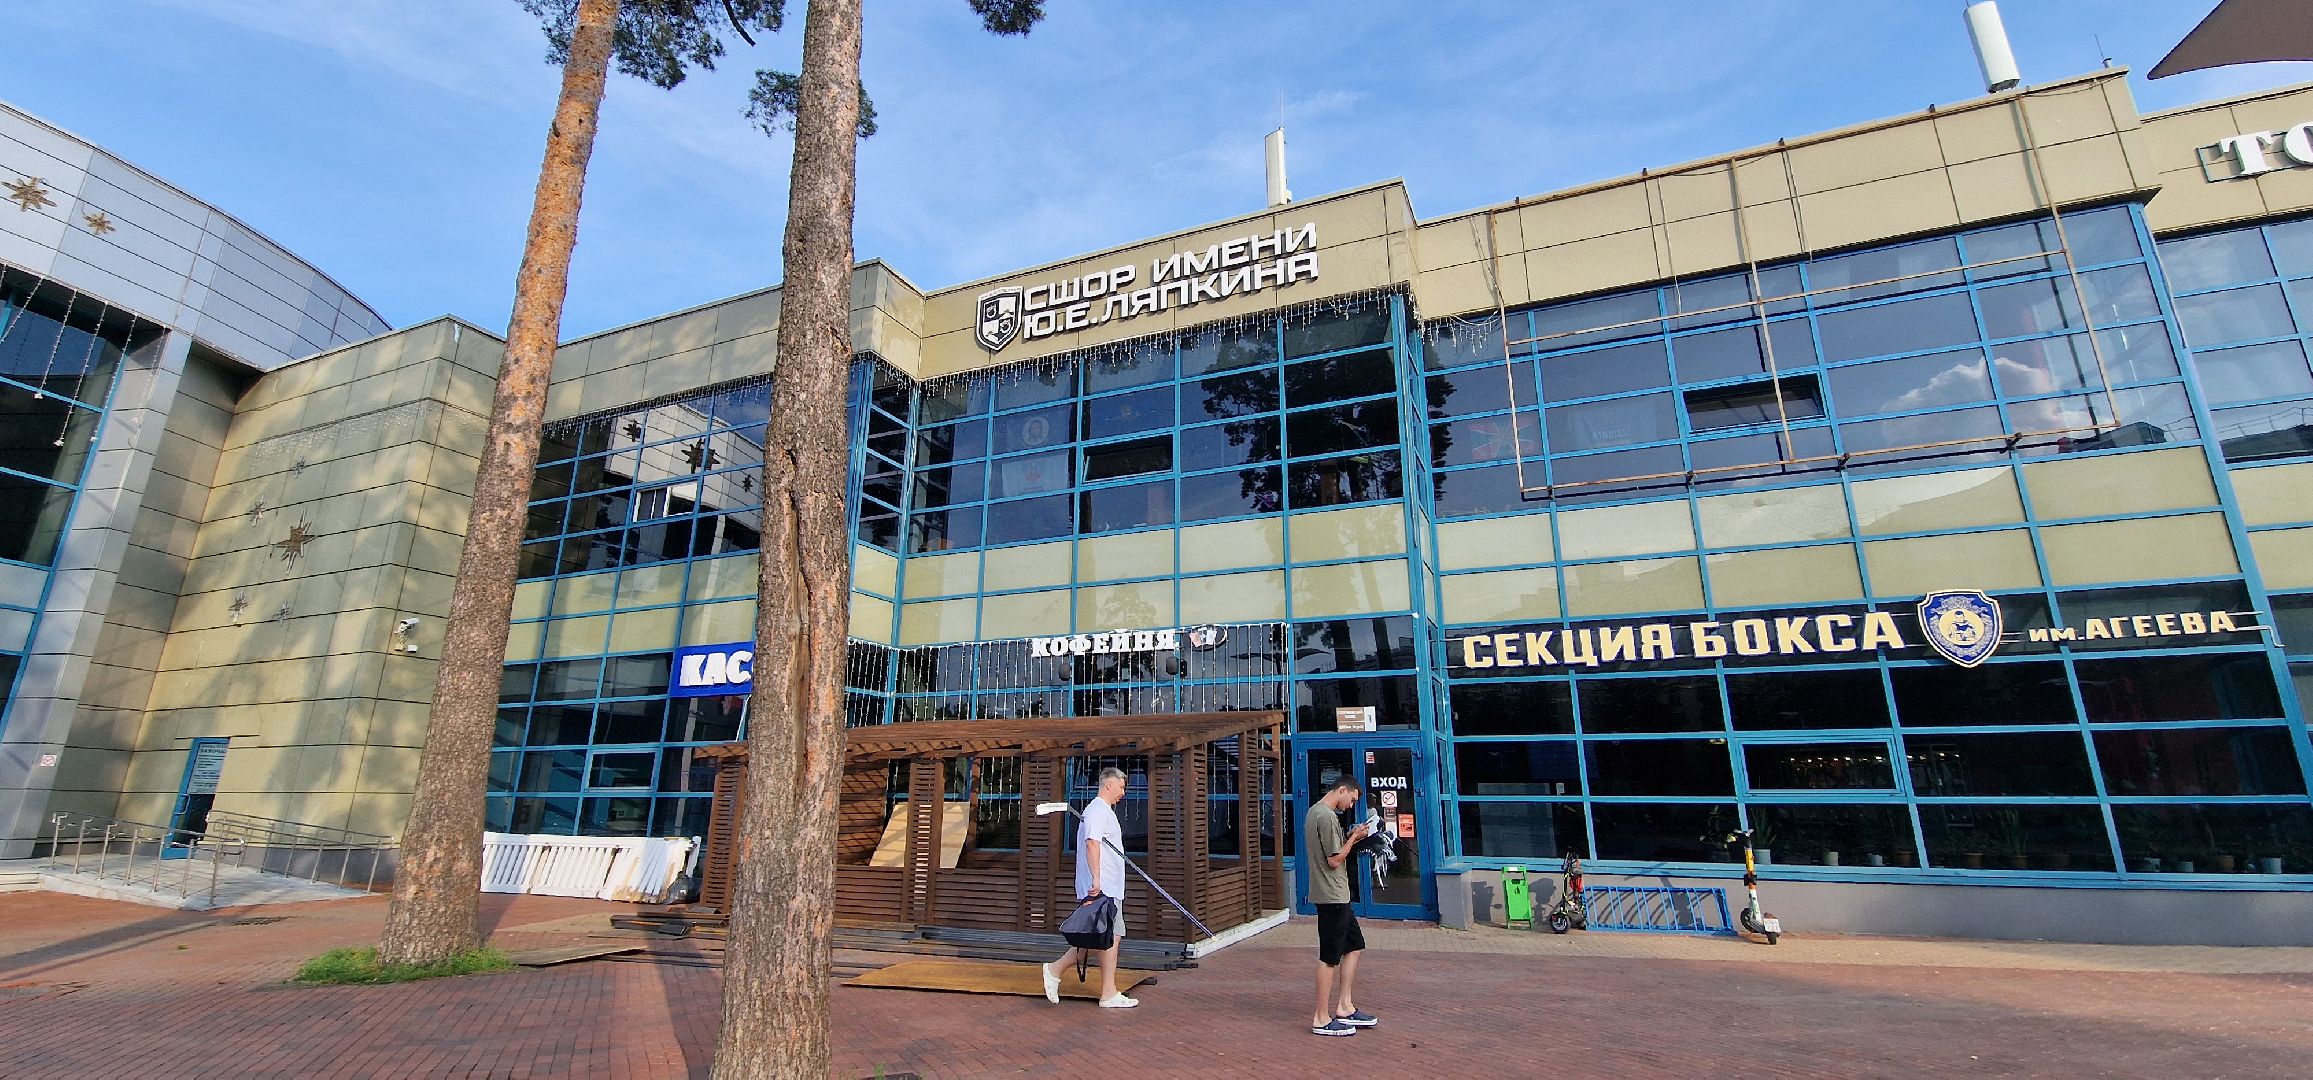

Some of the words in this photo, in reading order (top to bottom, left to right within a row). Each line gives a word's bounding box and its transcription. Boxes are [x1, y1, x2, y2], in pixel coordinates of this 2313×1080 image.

[1023, 264, 1136, 311] СШОР
[1153, 222, 1317, 284] ИМЕНИ
[1031, 628, 1176, 658] КОФЕЙНЯ
[1463, 624, 1675, 669] СЕКЦИЯ
[1690, 612, 1906, 658] БОКСА
[679, 650, 753, 686] КАС
[1370, 776, 1408, 790] ВХОД
